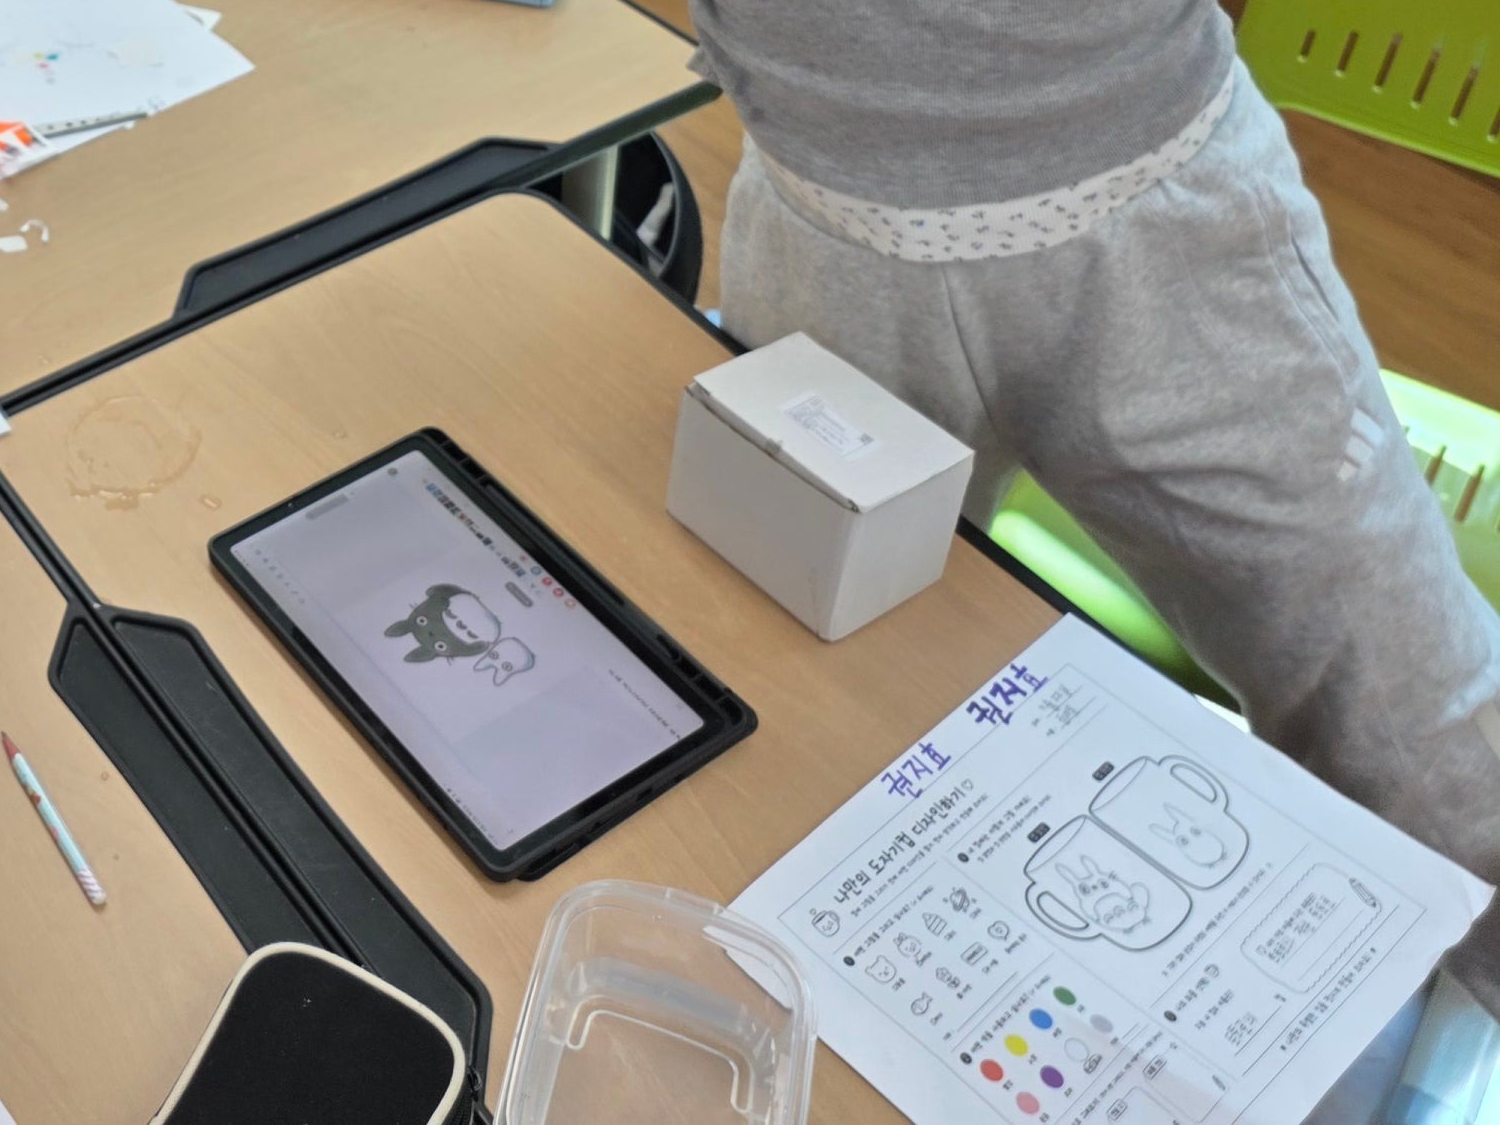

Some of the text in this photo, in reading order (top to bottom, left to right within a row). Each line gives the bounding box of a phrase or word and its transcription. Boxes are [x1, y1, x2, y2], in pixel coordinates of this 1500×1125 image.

[834, 870, 871, 903] 나만의
[868, 832, 915, 875] 도자기컵
[912, 787, 965, 835] 디자인하기
